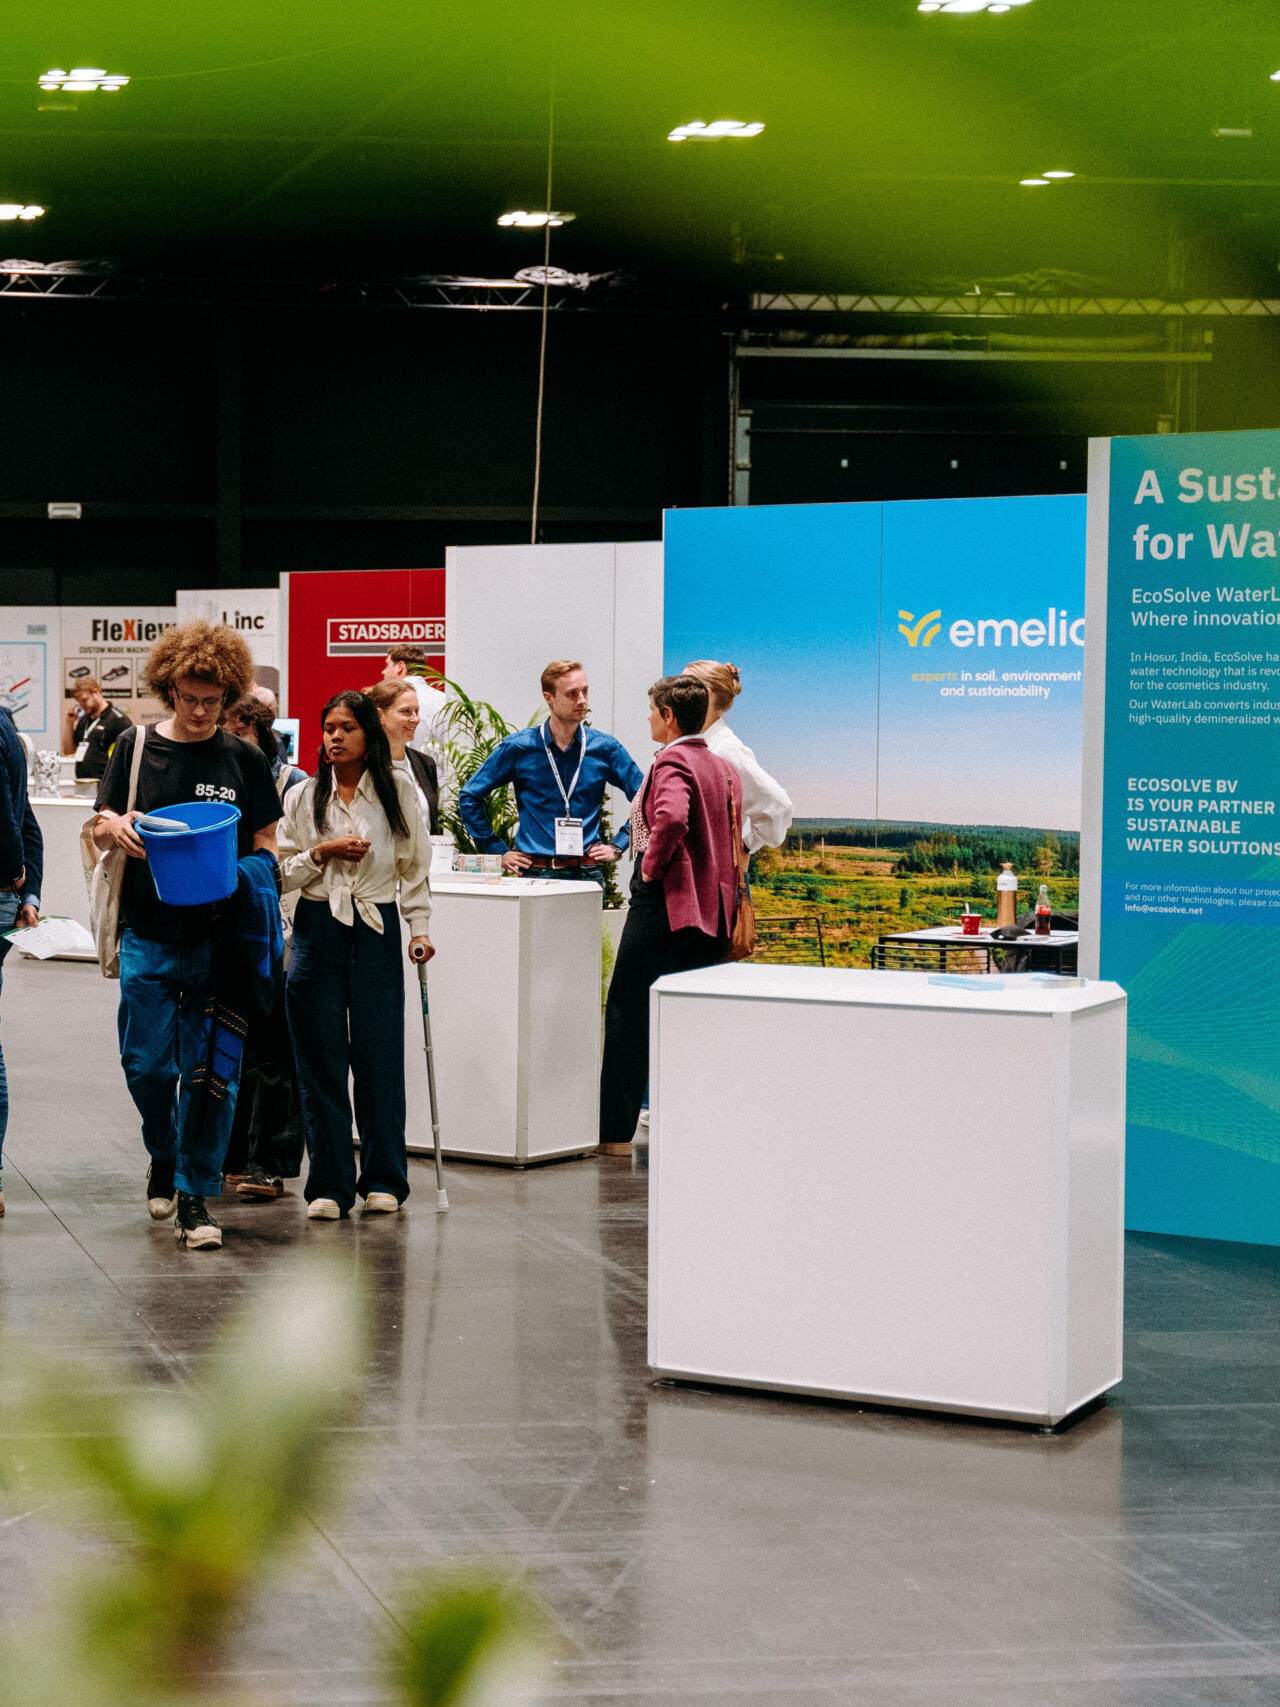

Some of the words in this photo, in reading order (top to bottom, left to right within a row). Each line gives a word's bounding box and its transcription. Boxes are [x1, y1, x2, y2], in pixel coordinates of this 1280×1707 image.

[1134, 470, 1164, 504] A
[1178, 467, 1280, 503] Sust
[1133, 524, 1194, 560] for
[1206, 523, 1280, 559] Wa
[1132, 587, 1211, 603] EcoSolve
[1131, 611, 1188, 626] Where
[339, 624, 445, 640] STADSBADER
[1130, 652, 1141, 662] In
[1145, 652, 1177, 663] Hosur,
[1181, 652, 1211, 663] India,
[1214, 652, 1263, 662] EcoSolve
[912, 671, 959, 684] experts
[961, 670, 972, 681] in
[975, 670, 998, 682] soil,
[1002, 670, 1082, 681] environment
[1130, 667, 1160, 676] water
[1163, 666, 1221, 678] technology
[1224, 666, 1245, 676] that
[1248, 666, 1257, 676] is
[940, 685, 965, 696] and
[968, 684, 1051, 699] sustainability
[1130, 680, 1144, 690] for
[1147, 680, 1164, 690] the
[1166, 680, 1220, 690] cosmetics
[1223, 680, 1270, 692] industry.
[1129, 700, 1148, 709] Our
[1151, 699, 1202, 709] WaterLab
[1204, 701, 1250, 710] converts
[1129, 712, 1192, 725] high-quality
[1194, 713, 1271, 724] demineralized
[195, 784, 236, 801] 85-20
[1128, 777, 1211, 793] ECOSOLVE
[1216, 779, 1238, 793] BV
[1127, 798, 1144, 811] IS
[1148, 798, 1193, 812] YOUR
[1198, 800, 1275, 814] PARTNER
[1127, 818, 1241, 834] SUSTAINABLE
[1126, 838, 1183, 852] WATER
[1125, 882, 1138, 891] For
[1163, 884, 1211, 893] information
[1213, 885, 1237, 895] about
[1157, 894, 1179, 903] other
[1239, 898, 1266, 907] please
